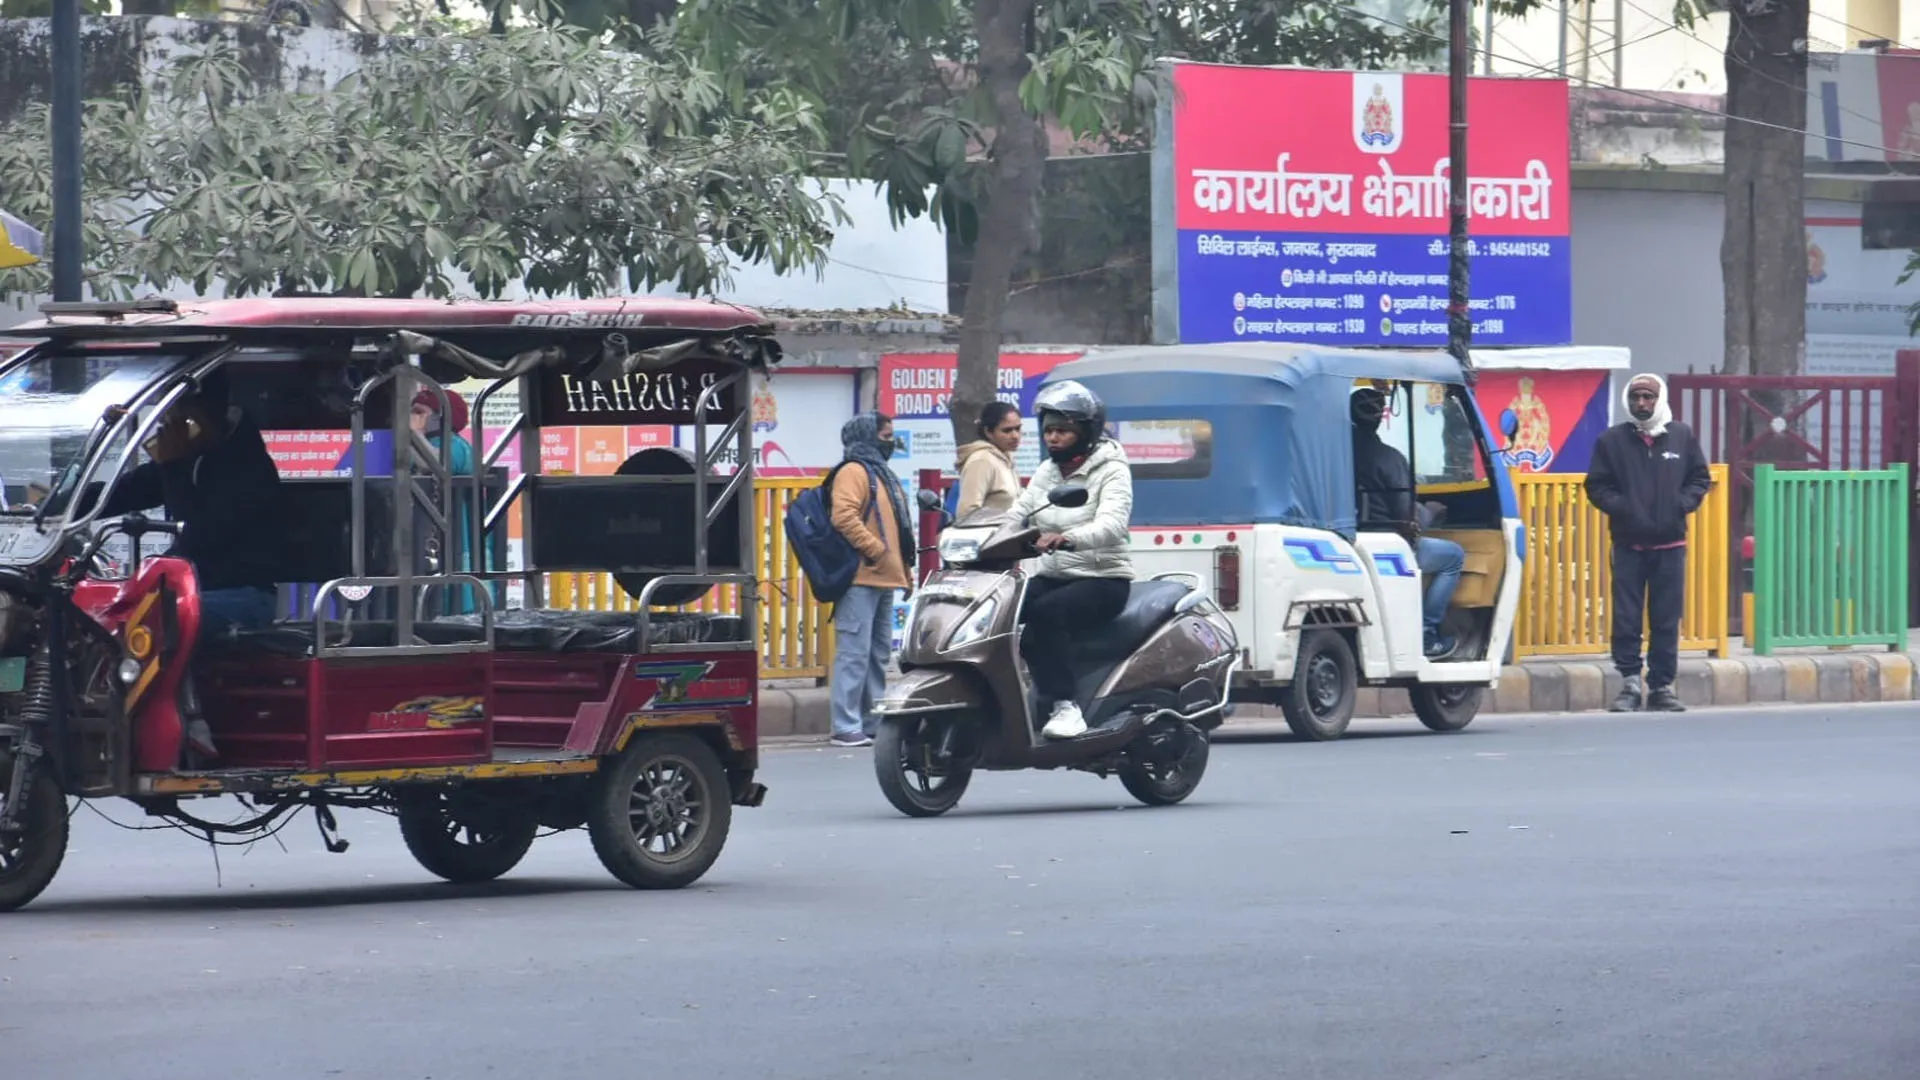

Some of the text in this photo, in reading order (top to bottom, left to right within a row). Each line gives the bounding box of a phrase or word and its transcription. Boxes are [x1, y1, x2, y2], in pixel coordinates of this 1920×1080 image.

[1192, 152, 1353, 218] कार्यालय
[891, 368, 945, 390] GOLDEN
[997, 368, 1023, 390] FOR
[895, 393, 933, 415] ROAD
